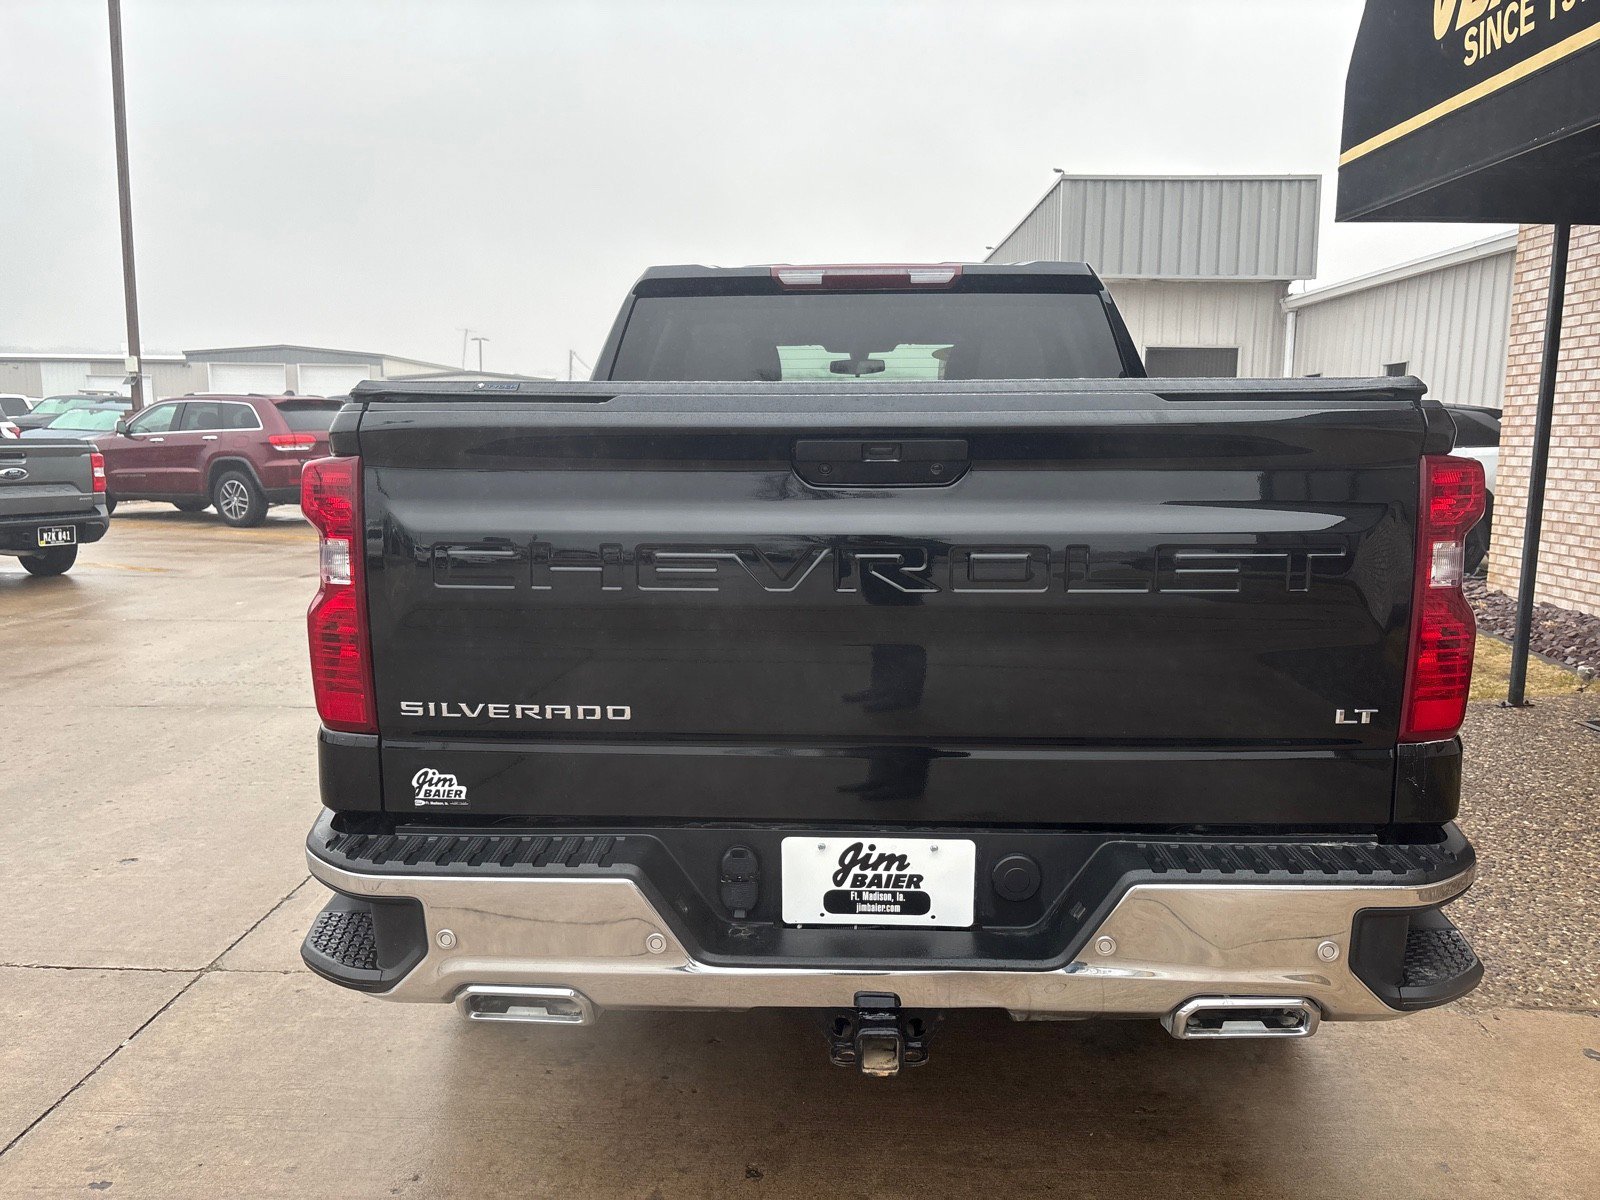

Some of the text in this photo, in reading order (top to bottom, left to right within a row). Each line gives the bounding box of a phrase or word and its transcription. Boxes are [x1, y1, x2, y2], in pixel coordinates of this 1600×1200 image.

[1463, 0, 1535, 66] SINCE
[432, 541, 1347, 593] CHEVROLET
[400, 701, 631, 720] SILVERADO
[1335, 709, 1378, 724] LT
[415, 769, 456, 797] Jim
[423, 788, 464, 799] BAIER
[832, 842, 910, 887] Jim
[850, 873, 924, 889] BAIER
[850, 891, 859, 901] Ft.
[862, 891, 894, 903] Madison,
[856, 902, 901, 914] jimbaier.com
